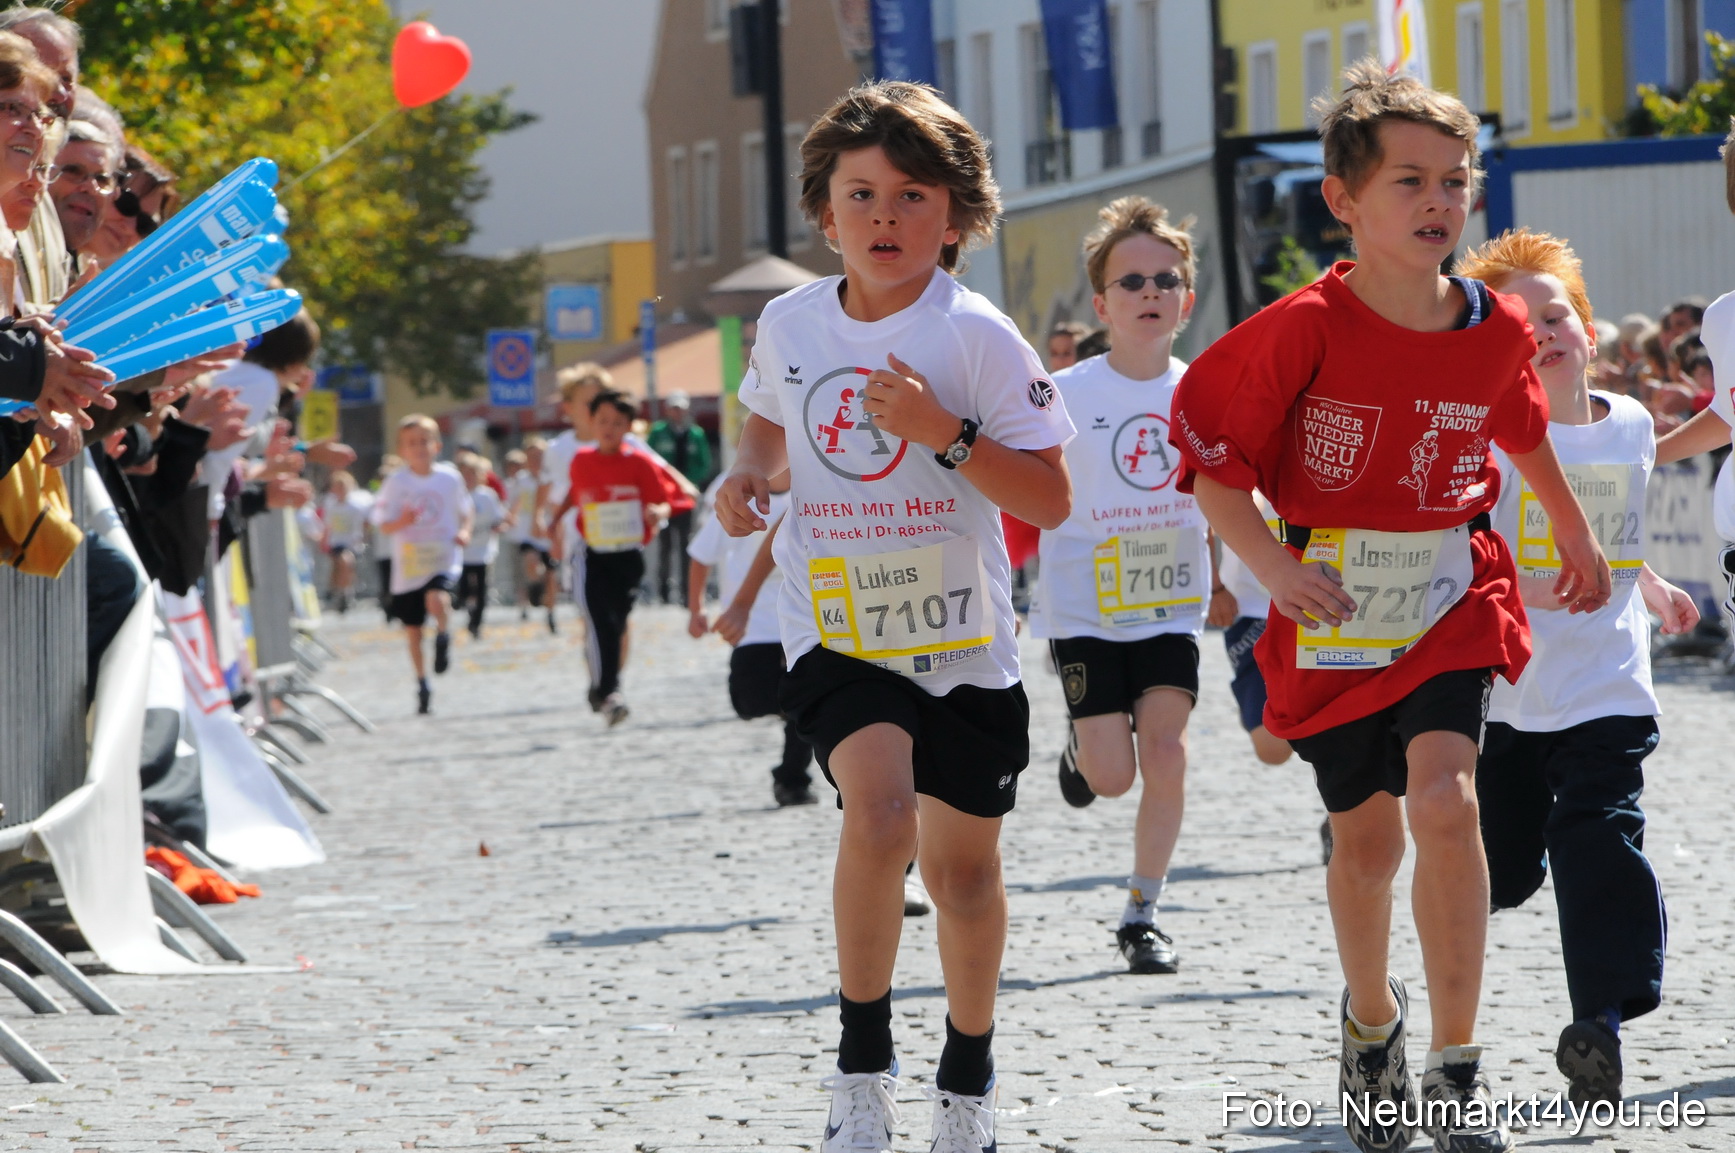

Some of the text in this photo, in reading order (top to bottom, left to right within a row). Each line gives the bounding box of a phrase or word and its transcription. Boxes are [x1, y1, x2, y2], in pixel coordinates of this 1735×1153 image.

[1305, 406, 1363, 432] IMMER
[1414, 400, 1434, 414] 11.
[1303, 419, 1364, 447] WIEDER
[1304, 434, 1358, 466] NEU
[1304, 453, 1354, 481] MARKT
[862, 502, 895, 517] MIT
[905, 497, 956, 518] HERZ
[1092, 507, 1142, 521] LAUFEN
[1147, 504, 1170, 516] MIT
[1526, 509, 1546, 527] K4
[1591, 511, 1639, 546] 122
[1123, 541, 1167, 558] Tilman
[1351, 541, 1432, 568] Joshua
[854, 563, 919, 590] Lukas
[1127, 563, 1191, 593] 7105
[865, 587, 973, 637] 7107
[1352, 576, 1458, 624] 7272
[822, 608, 845, 626] K4
[1317, 651, 1364, 662] BOCK
